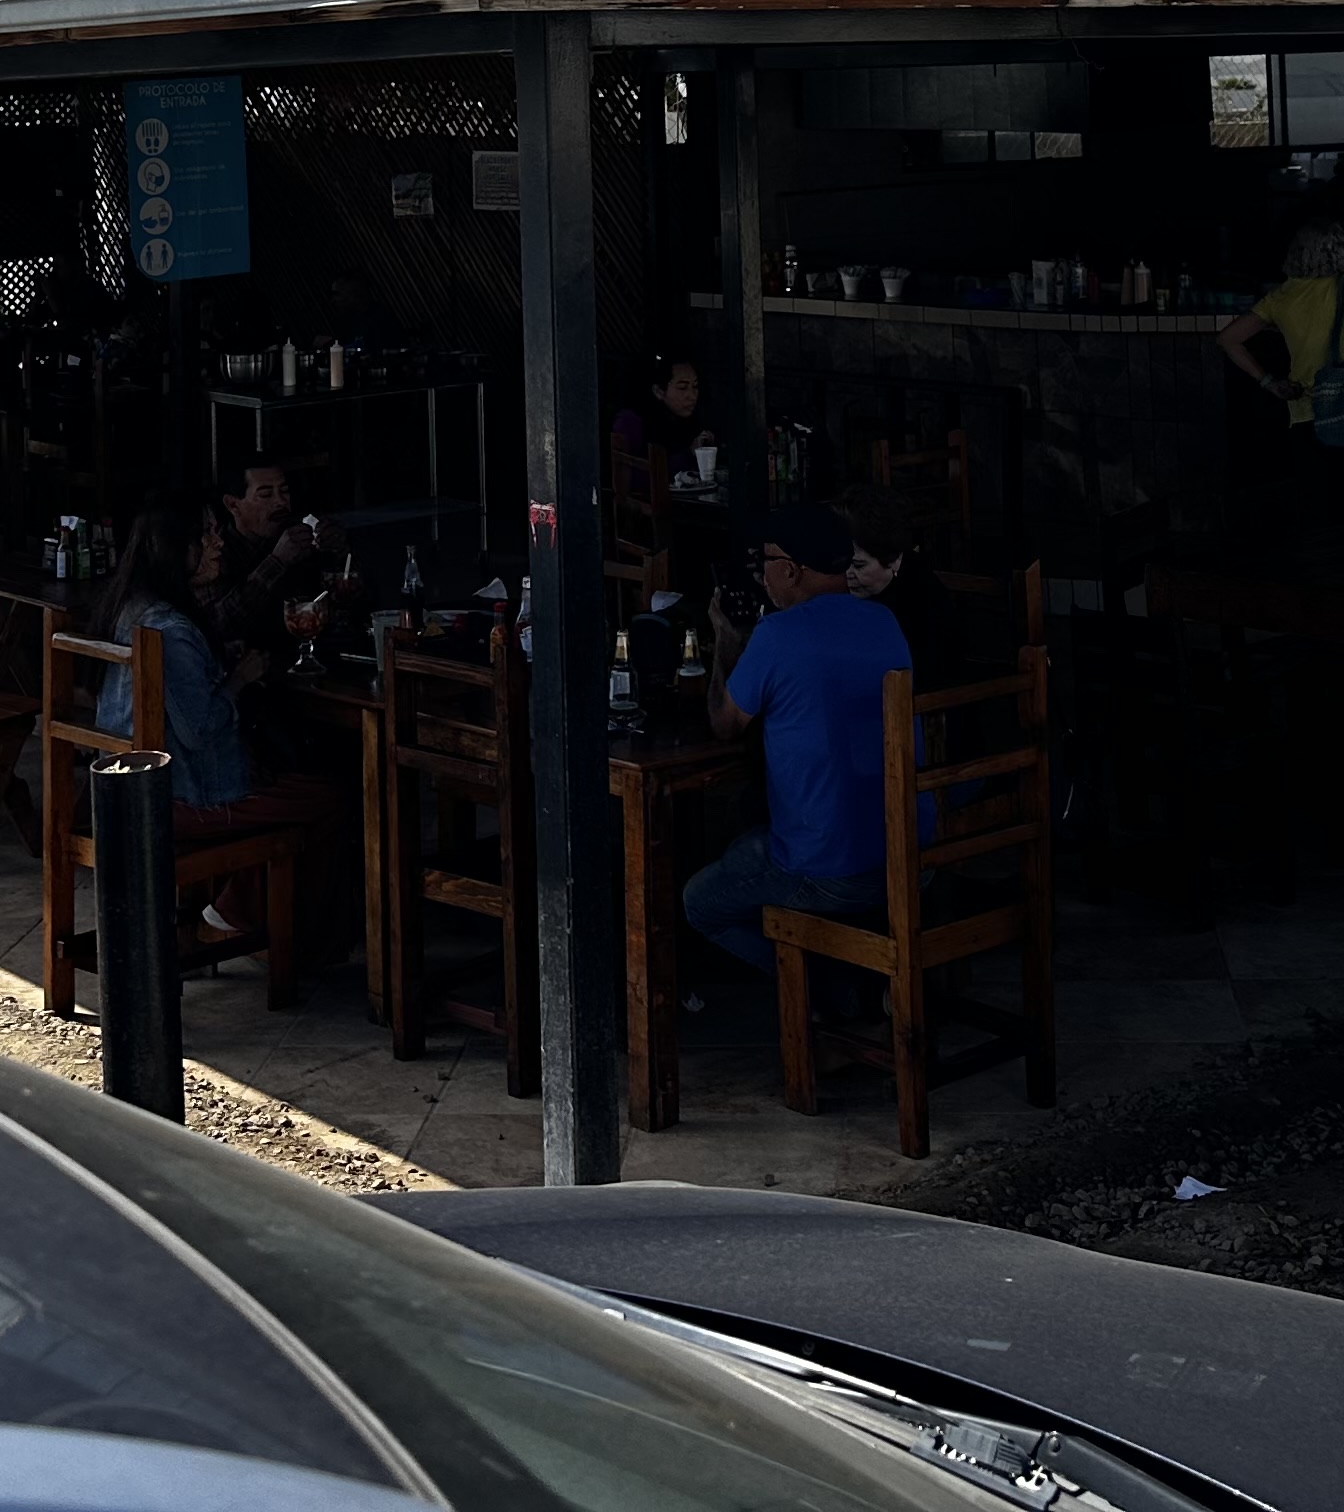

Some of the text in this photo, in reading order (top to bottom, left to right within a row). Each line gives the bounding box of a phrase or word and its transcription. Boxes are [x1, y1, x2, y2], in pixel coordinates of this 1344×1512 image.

[139, 82, 225, 97] PROTOCOLO DE
[160, 96, 207, 109] ENTRADA
